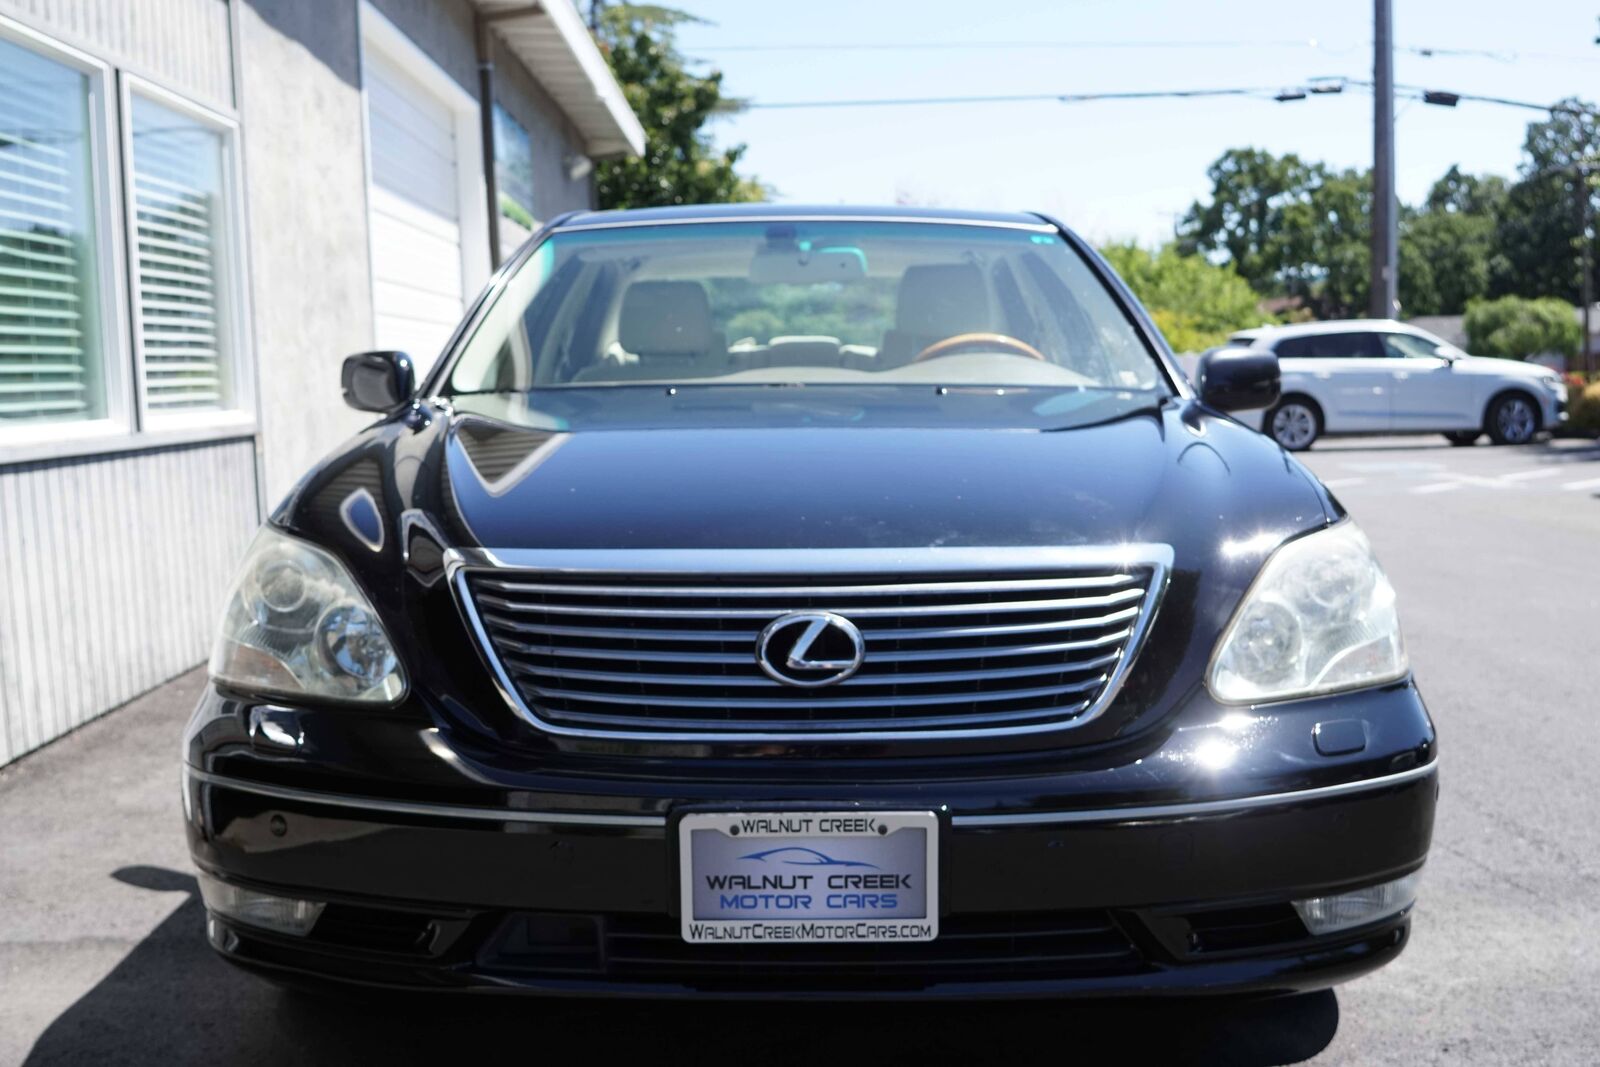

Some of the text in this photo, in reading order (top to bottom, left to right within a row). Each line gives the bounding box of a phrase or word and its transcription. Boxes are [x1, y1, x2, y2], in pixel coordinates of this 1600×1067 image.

[741, 818, 875, 833] WALNUT CREEK
[706, 874, 912, 890] WALNUT CREEK
[720, 894, 898, 909] MOTOR CARS
